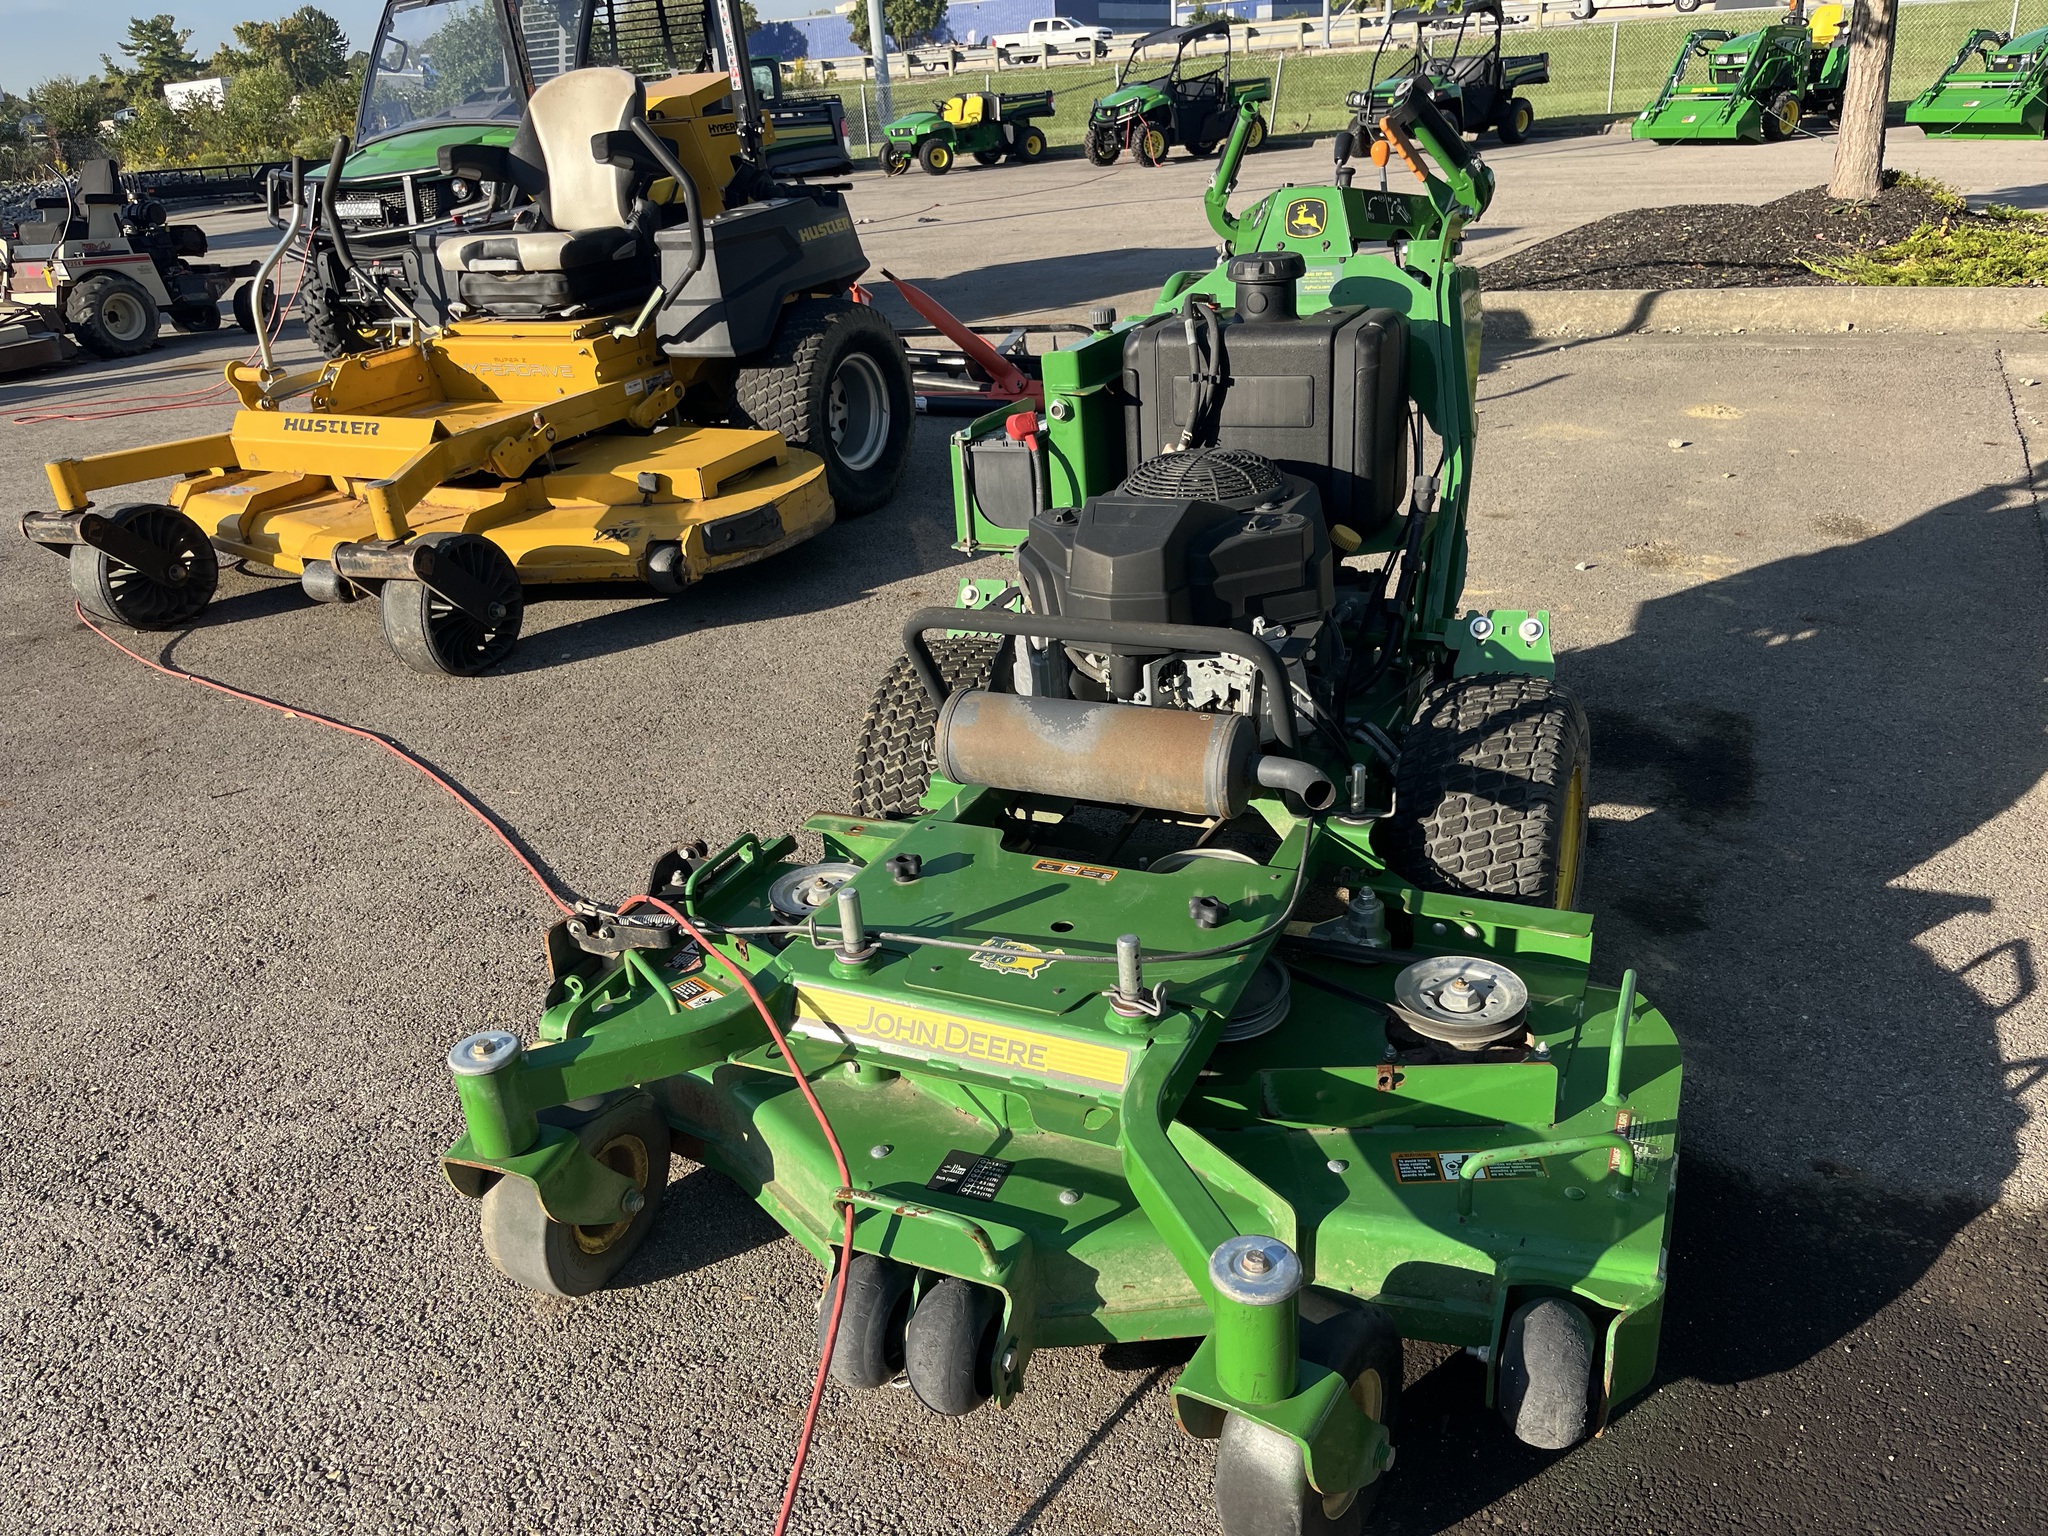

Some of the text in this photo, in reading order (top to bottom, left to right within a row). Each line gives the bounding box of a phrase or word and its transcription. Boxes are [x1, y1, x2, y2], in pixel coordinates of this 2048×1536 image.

[799, 217, 850, 243] HUSTLER
[284, 418, 380, 436] HUSTLER
[857, 1007, 1048, 1068] JOHN DEERE
[1617, 1113, 1628, 1133] PELIGRO
[1612, 1148, 1621, 1165] DANGE
